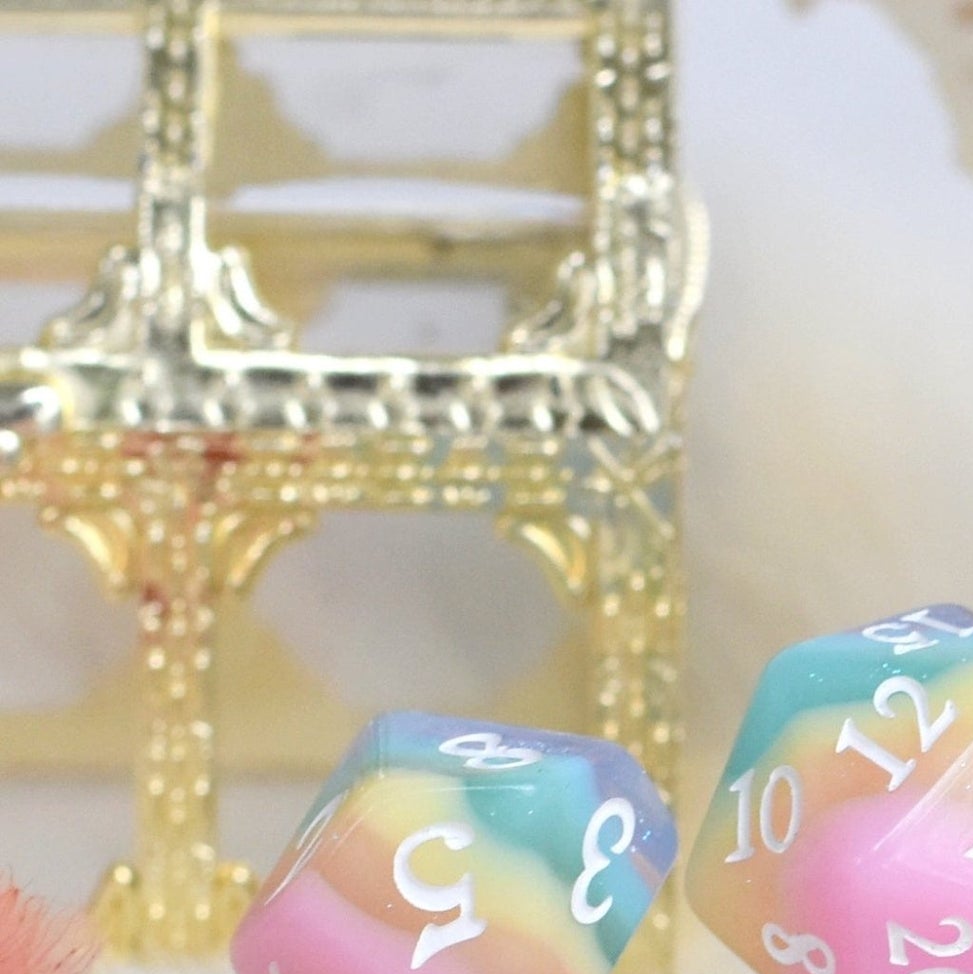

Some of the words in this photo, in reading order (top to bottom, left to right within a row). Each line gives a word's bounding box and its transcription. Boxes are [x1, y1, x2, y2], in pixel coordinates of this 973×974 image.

[438, 732, 542, 770] 8
[834, 675, 959, 792] 12
[570, 797, 635, 925] 3
[724, 765, 801, 864] 10
[392, 821, 488, 970] 5
